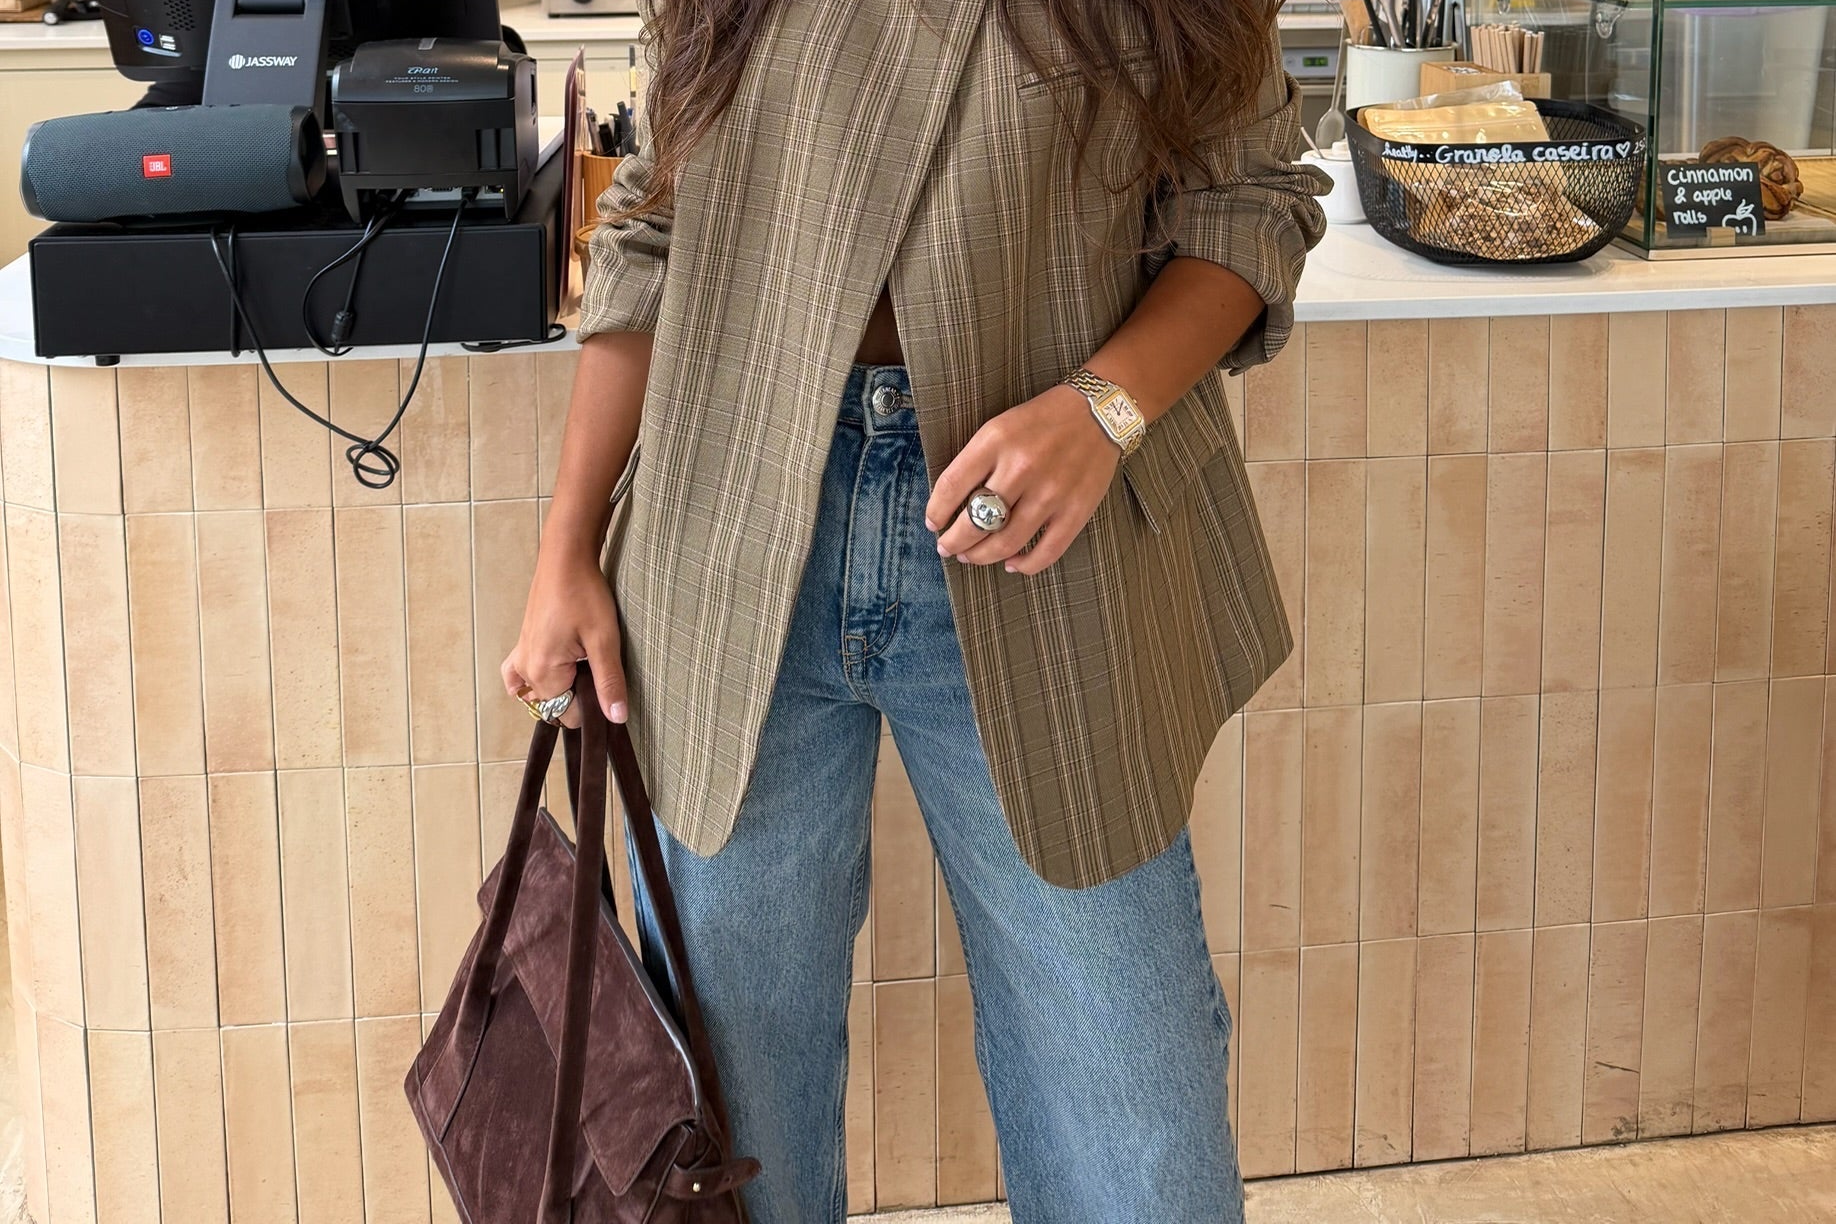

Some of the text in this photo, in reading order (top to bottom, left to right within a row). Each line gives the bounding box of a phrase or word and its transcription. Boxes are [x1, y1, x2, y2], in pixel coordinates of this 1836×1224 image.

[245, 56, 298, 67] JASSWAY
[1435, 143, 1526, 164] Granola
[1532, 142, 1613, 162] caseira
[149, 161, 167, 172] JBL
[1667, 166, 1753, 186] cinnamon
[1674, 186, 1733, 206] & apple
[1672, 209, 1707, 225] rolls
